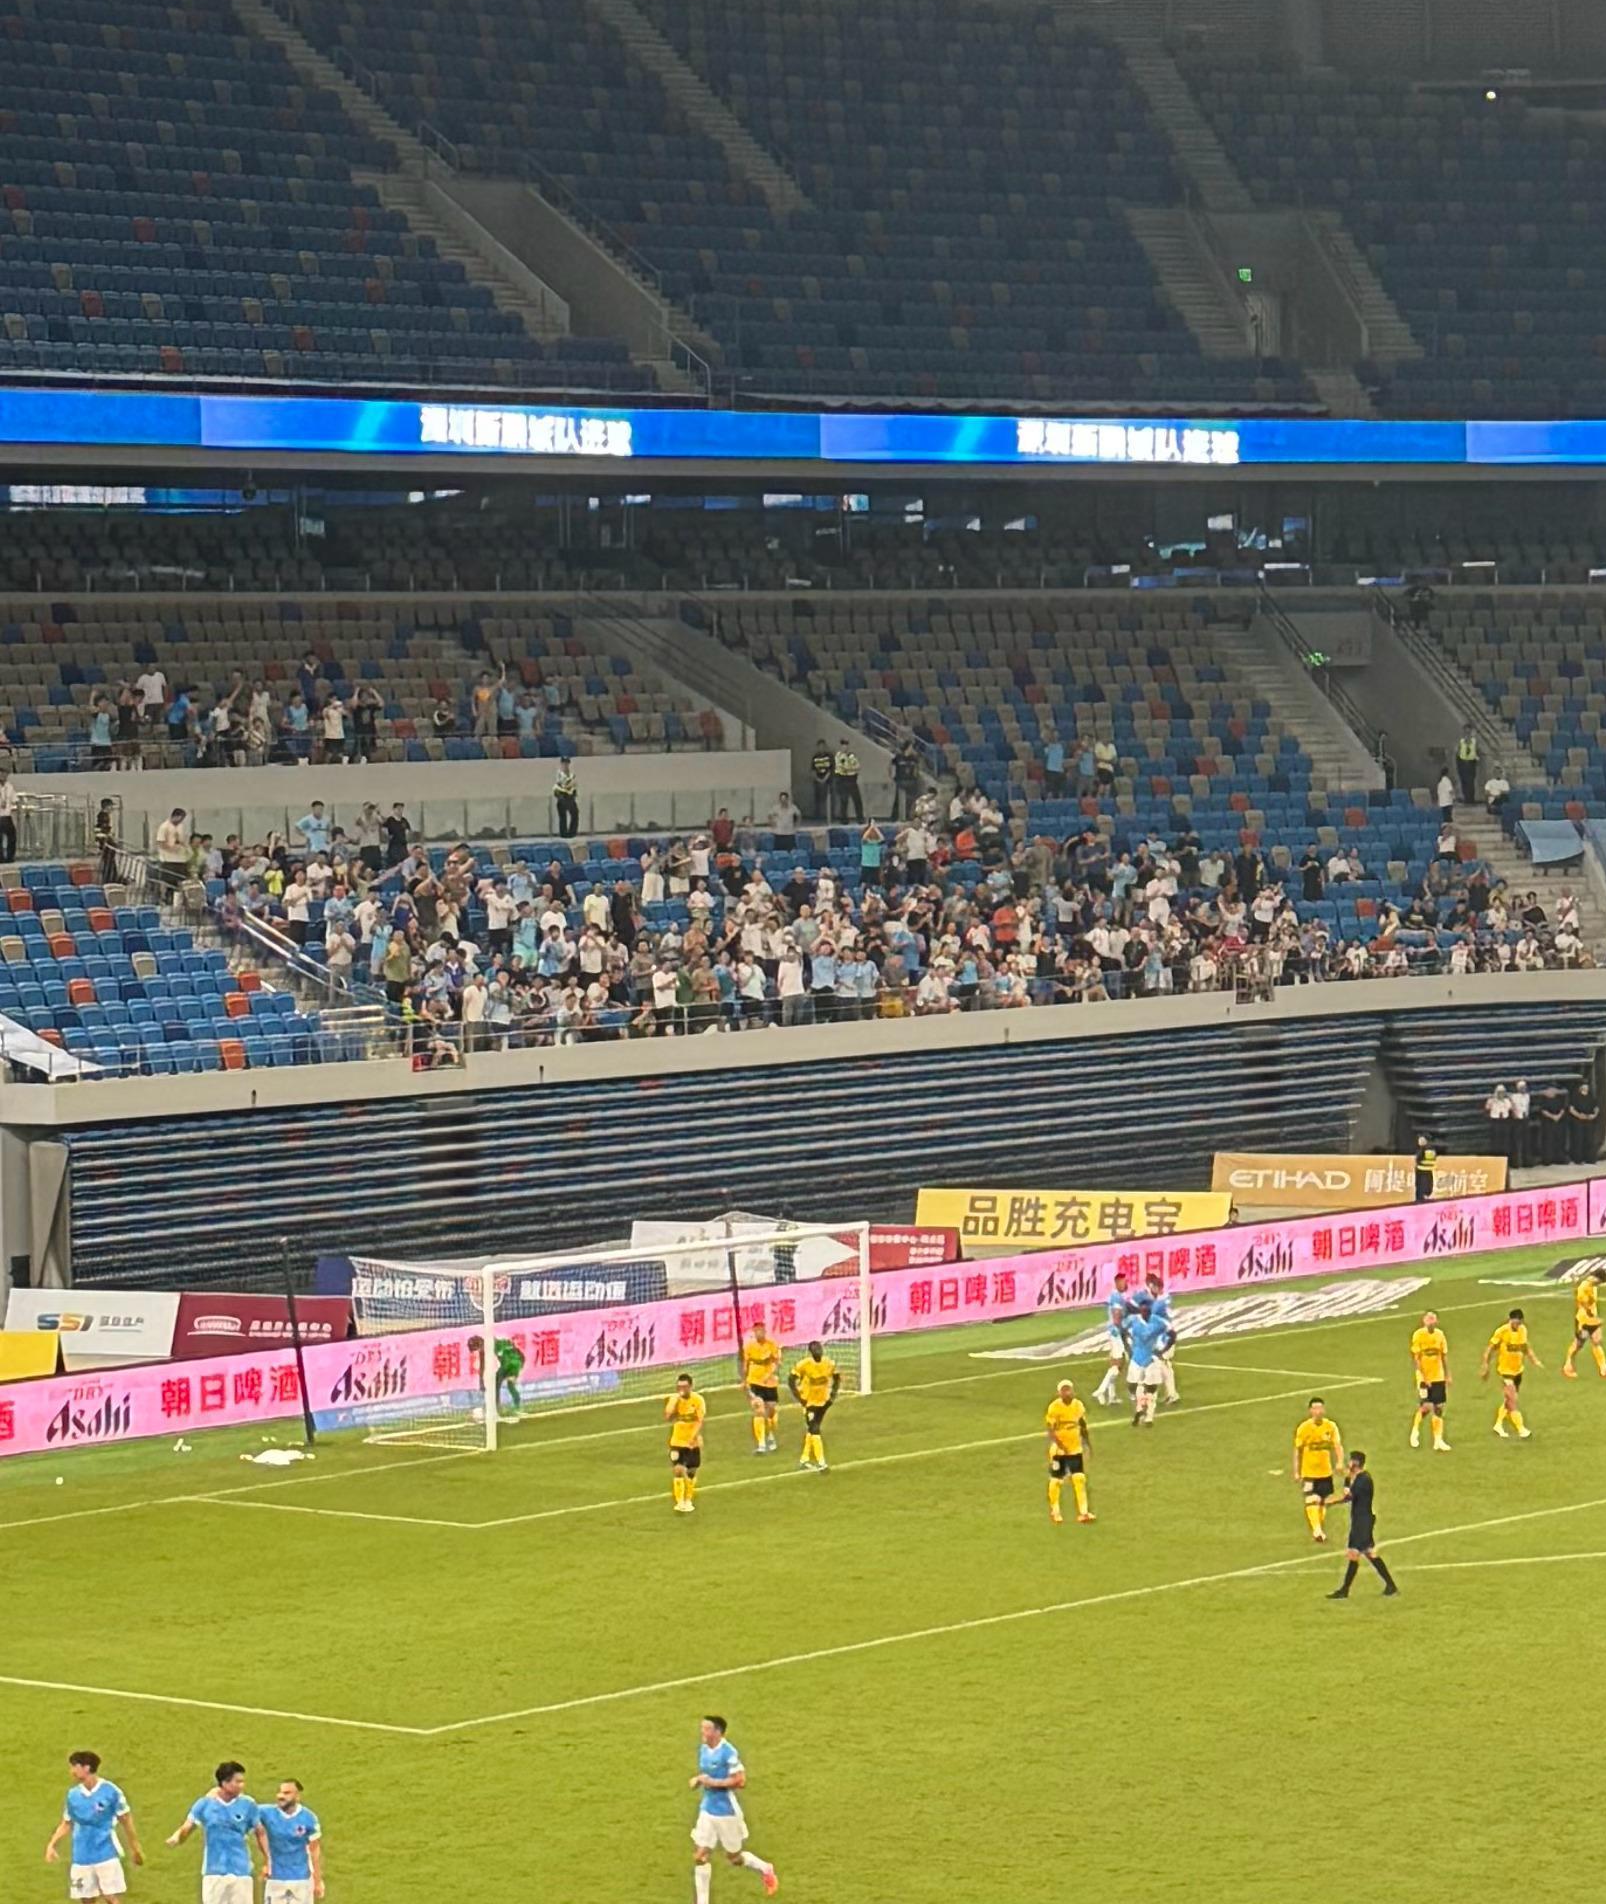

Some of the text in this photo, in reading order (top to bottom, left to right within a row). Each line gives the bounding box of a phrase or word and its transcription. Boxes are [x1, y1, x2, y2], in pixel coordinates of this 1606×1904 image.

[1228, 1169, 1351, 1189] ETIHAD
[962, 1195, 1183, 1238] 品胜充电宝
[1424, 1216, 1475, 1254] Asahi
[1491, 1196, 1580, 1238] 朝日啤酒
[1238, 1239, 1294, 1280] Asahi
[1312, 1218, 1405, 1261] 朝日啤酒
[909, 1270, 1016, 1315] 朝日啤酒
[1037, 1264, 1098, 1306] Asahi
[586, 1322, 656, 1369] Asahi
[160, 1363, 299, 1419] 朝日啤酒
[331, 1355, 407, 1403] Asahi
[46, 1392, 131, 1443] Asahi
